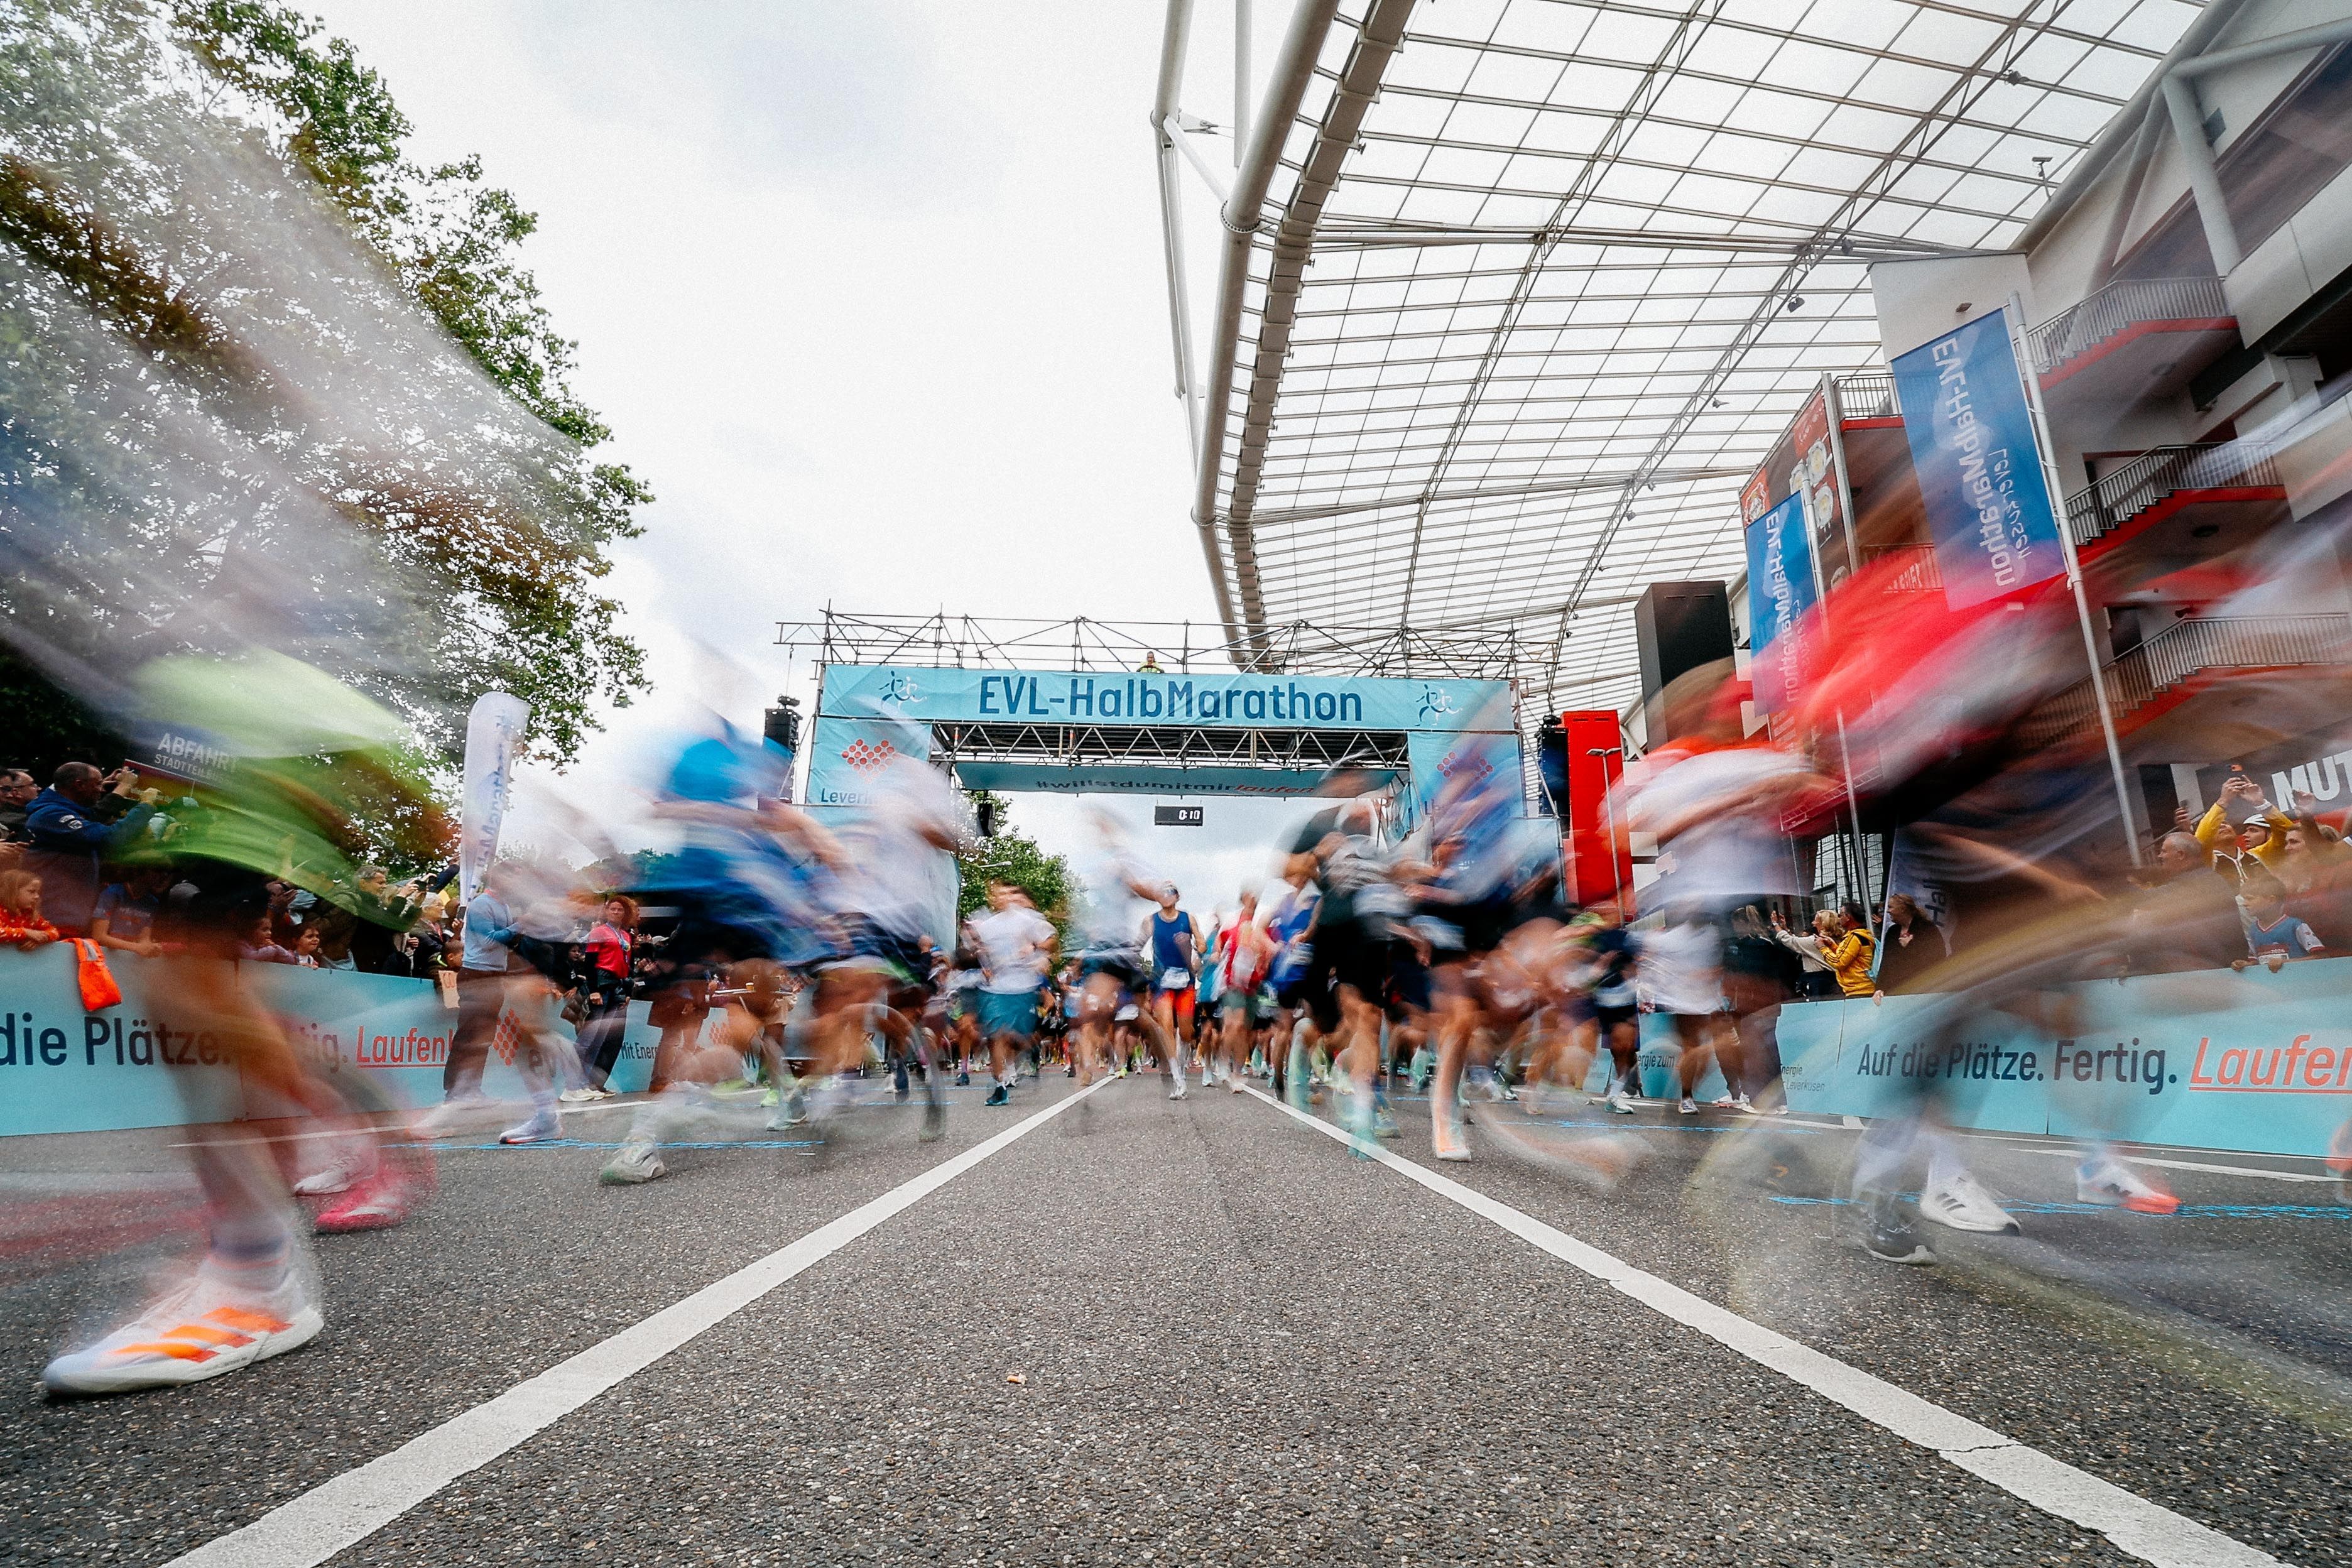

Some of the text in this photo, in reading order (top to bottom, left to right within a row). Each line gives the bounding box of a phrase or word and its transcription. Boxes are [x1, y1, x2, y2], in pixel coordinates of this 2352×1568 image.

[979, 676, 1362, 721] EVL-HalbMarathon
[1179, 810, 1200, 820] 0:10
[84, 1016, 230, 1066] Plätze.
[1782, 1064, 1803, 1077] nergie
[1857, 1043, 1898, 1076] Auf
[1901, 1042, 1940, 1078] die
[1947, 1042, 2044, 1081] Plätze.
[2054, 1038, 2177, 1095] Fertig.
